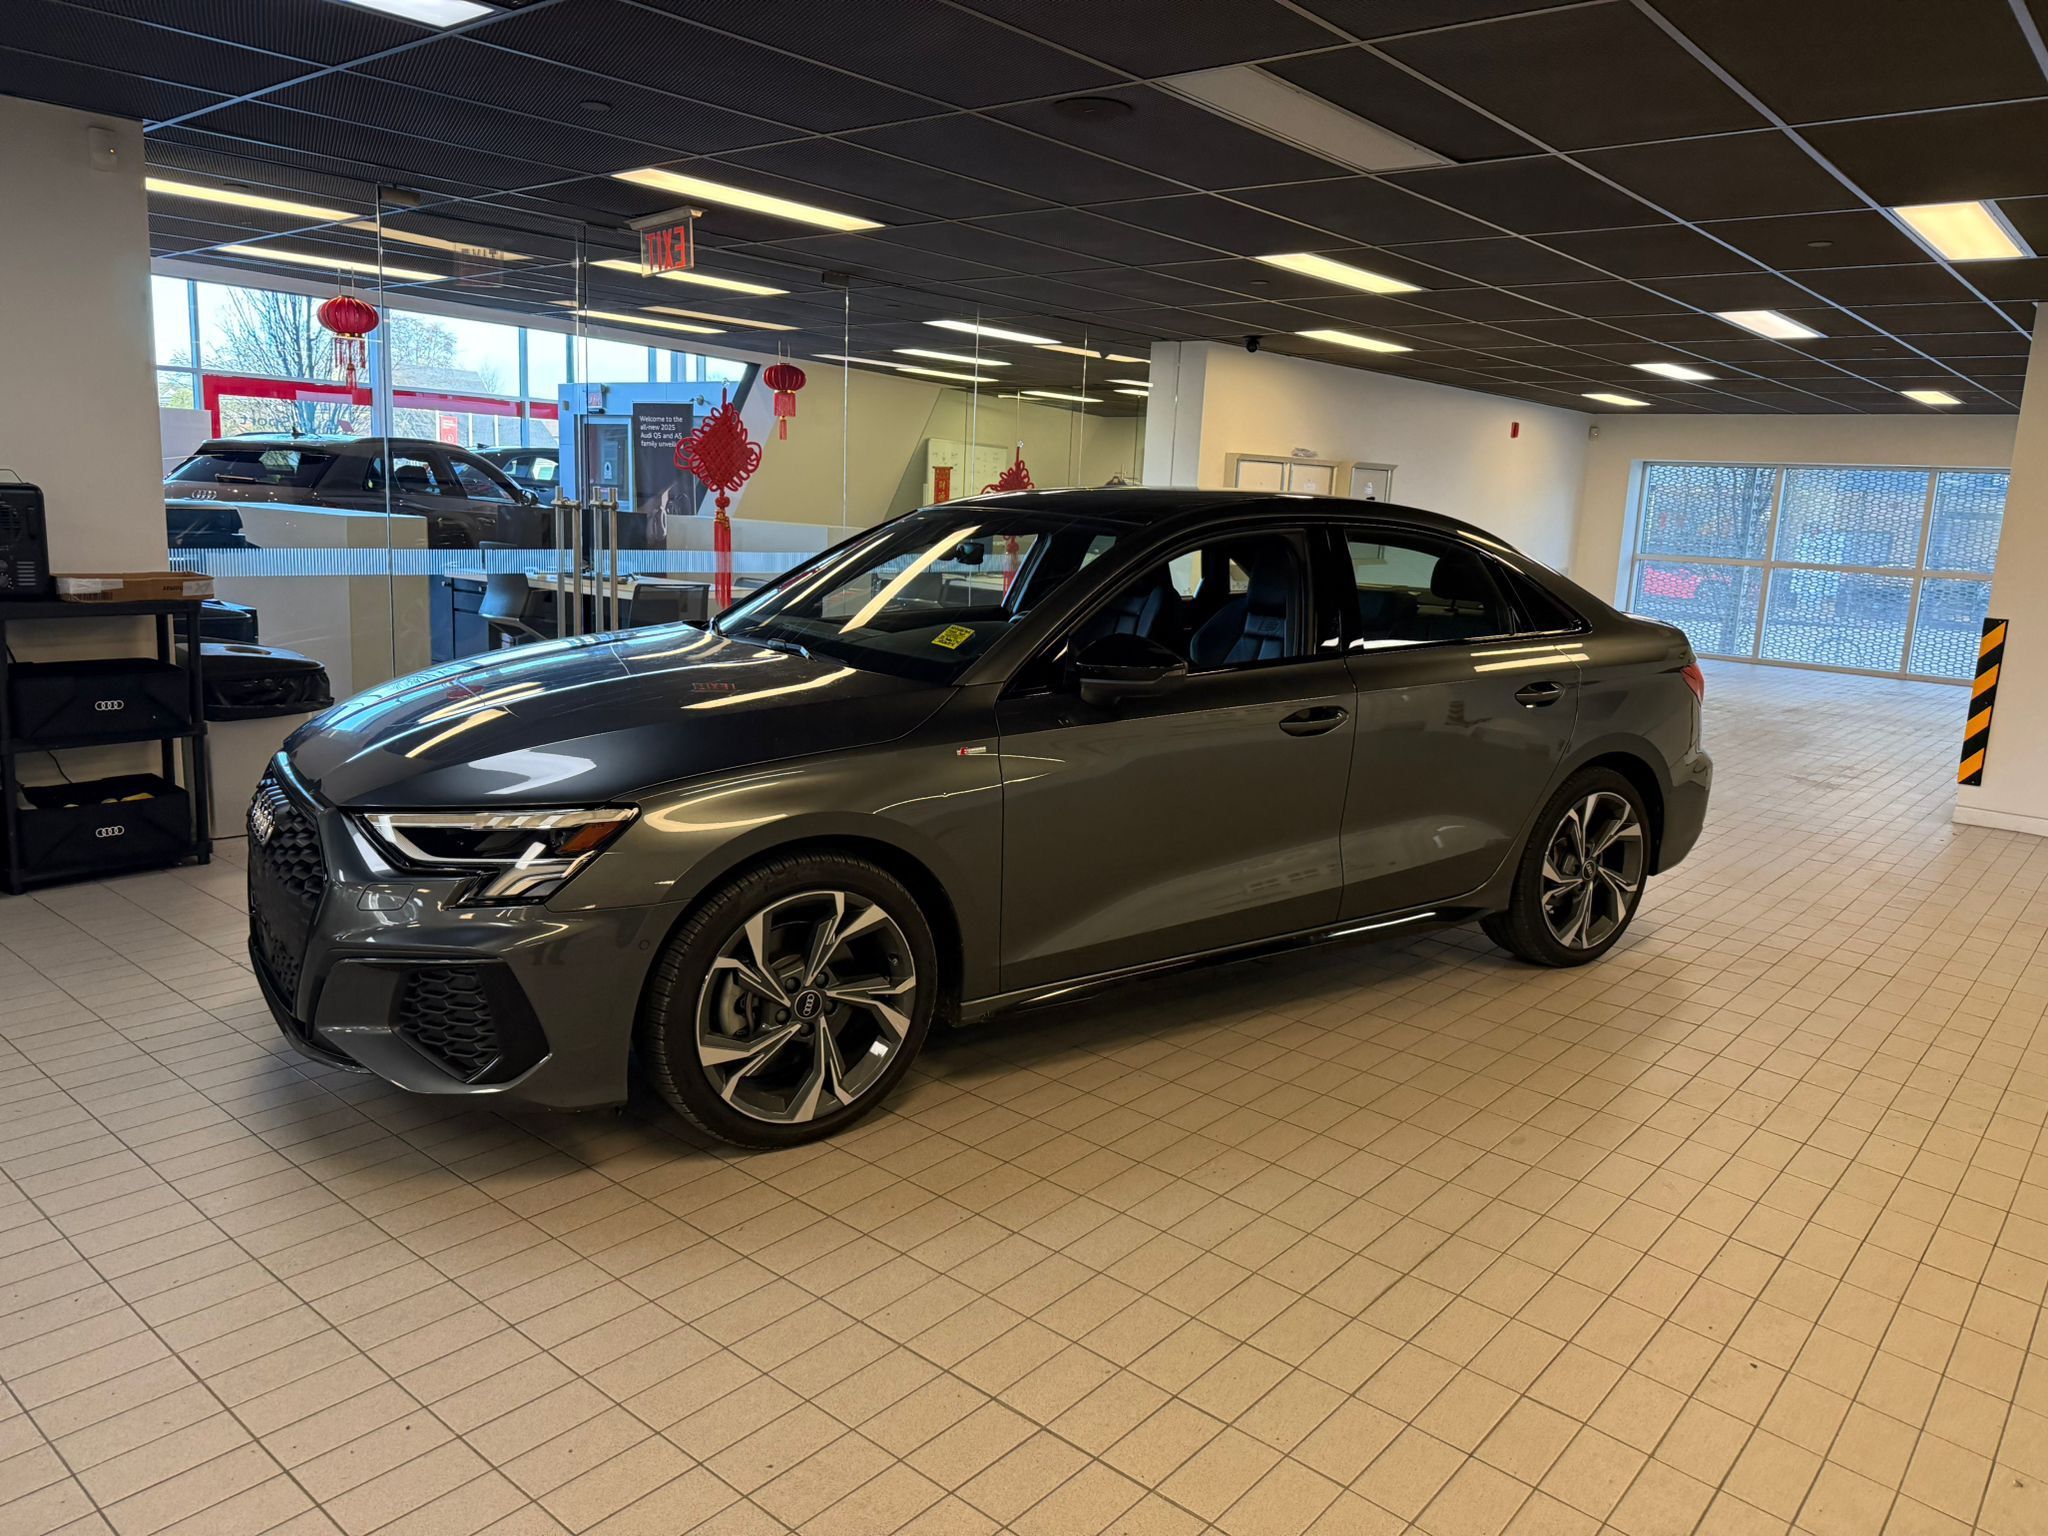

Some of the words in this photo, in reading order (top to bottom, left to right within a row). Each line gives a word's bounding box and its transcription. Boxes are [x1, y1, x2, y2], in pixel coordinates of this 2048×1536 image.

[653, 432, 662, 440] Q5
[674, 432, 683, 440] A5
[641, 440, 657, 449] family
